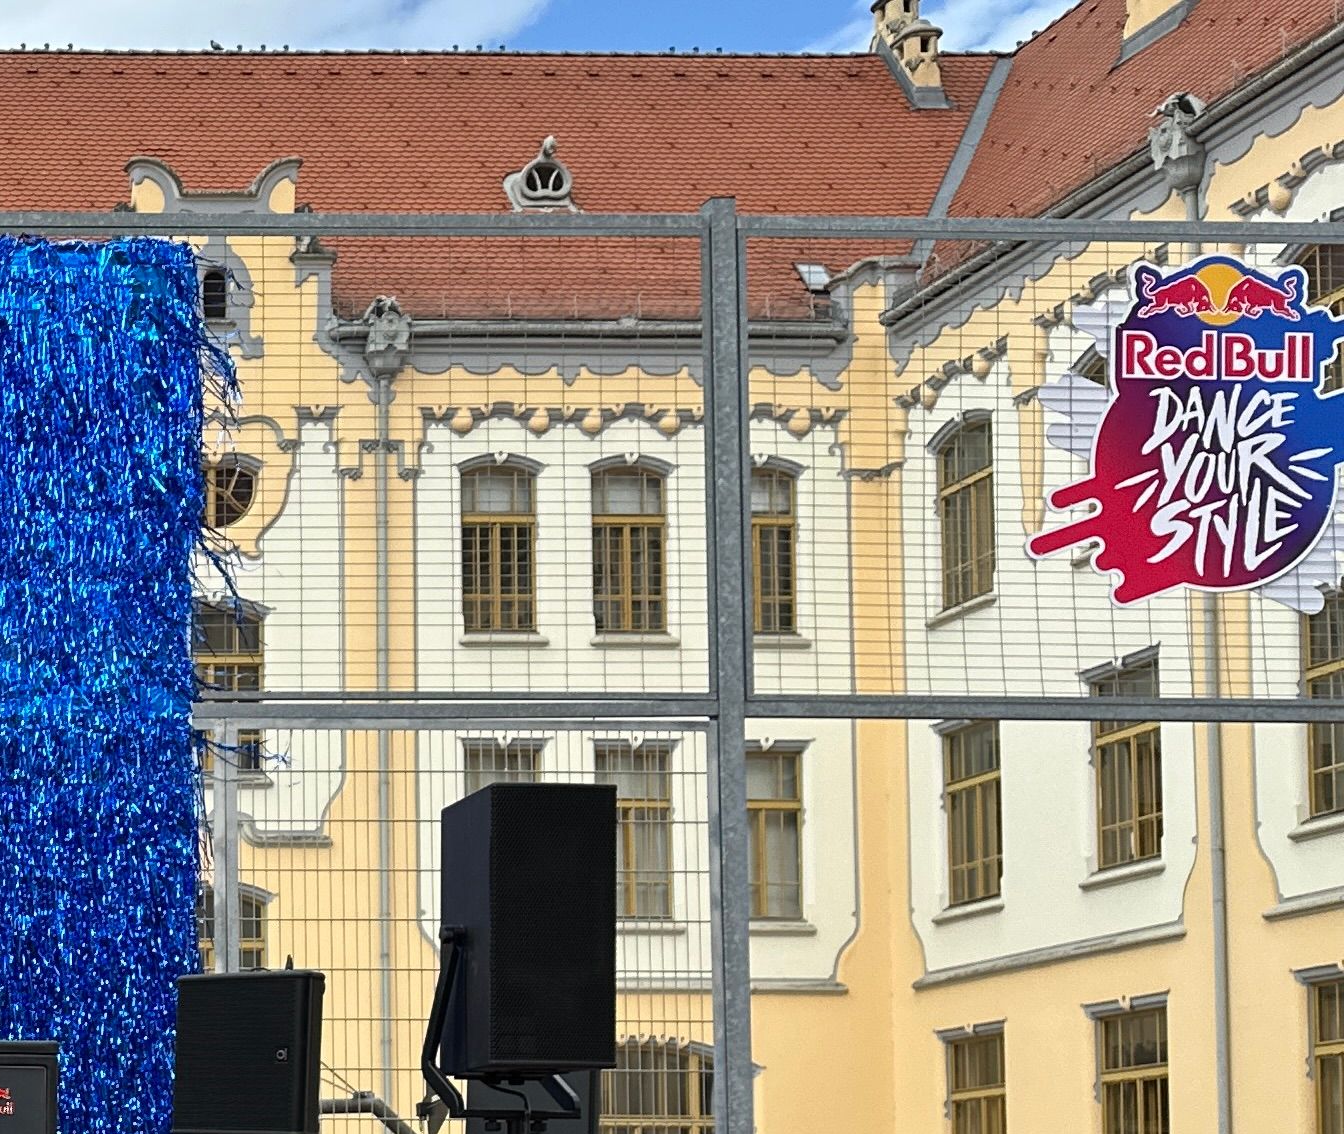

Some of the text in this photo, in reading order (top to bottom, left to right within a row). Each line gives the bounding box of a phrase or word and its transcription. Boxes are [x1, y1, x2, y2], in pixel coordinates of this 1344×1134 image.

[1123, 331, 1312, 380] Red Bull
[1141, 384, 1300, 455] DANCE
[1157, 433, 1313, 507] YOUR
[1147, 478, 1303, 577] STYLE
